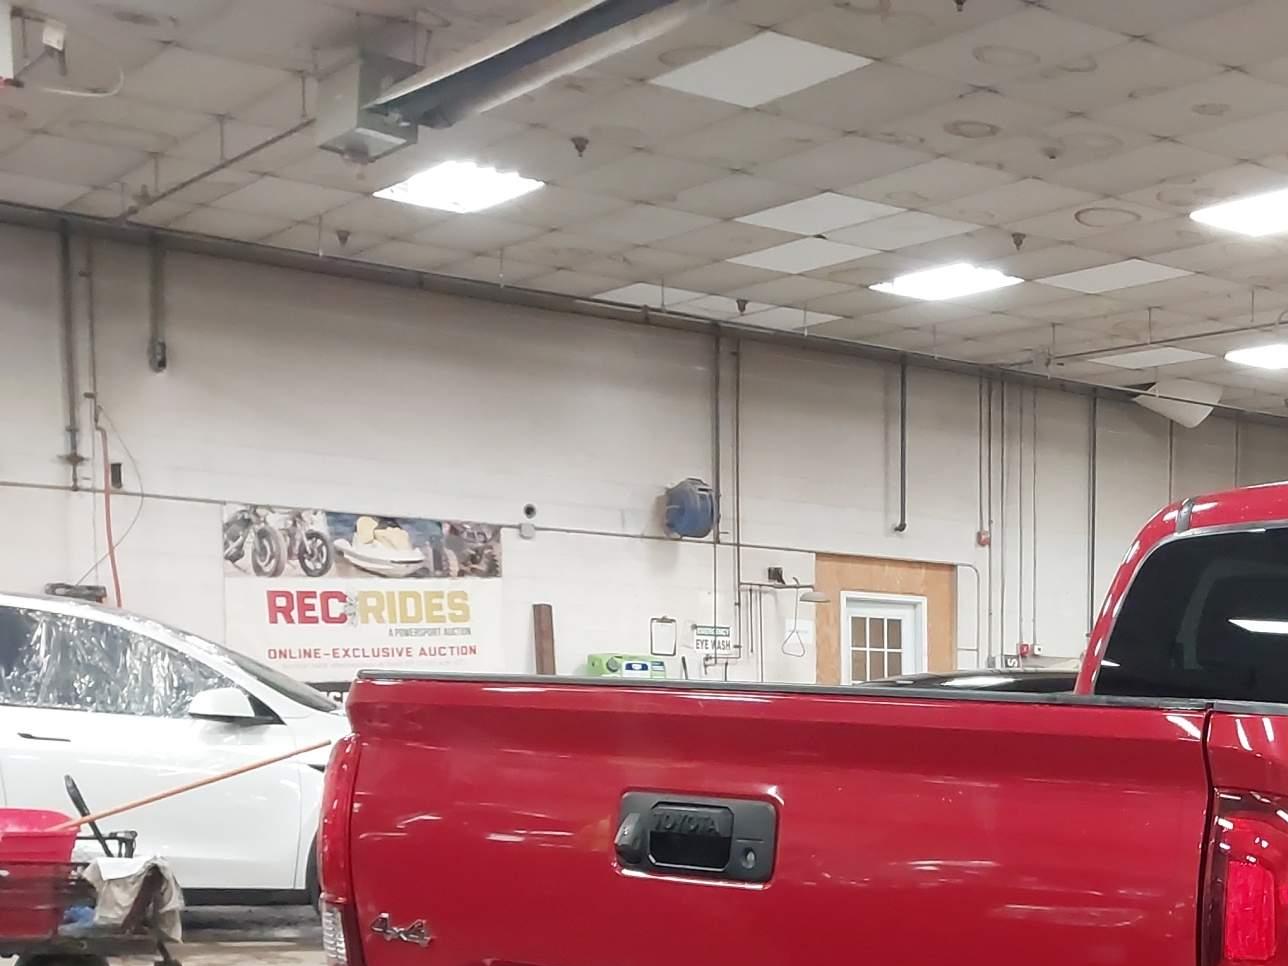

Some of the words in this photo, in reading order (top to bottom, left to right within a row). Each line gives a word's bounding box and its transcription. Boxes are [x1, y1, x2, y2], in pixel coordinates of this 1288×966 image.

[266, 590, 348, 625] REC
[357, 590, 471, 625] RIDES
[267, 647, 413, 660] ONLINE-EXCLUSIVE
[418, 645, 478, 657] AUCTION
[695, 638, 710, 650] EYE
[652, 812, 721, 837] TOYOTA
[370, 912, 435, 948] 4x4
